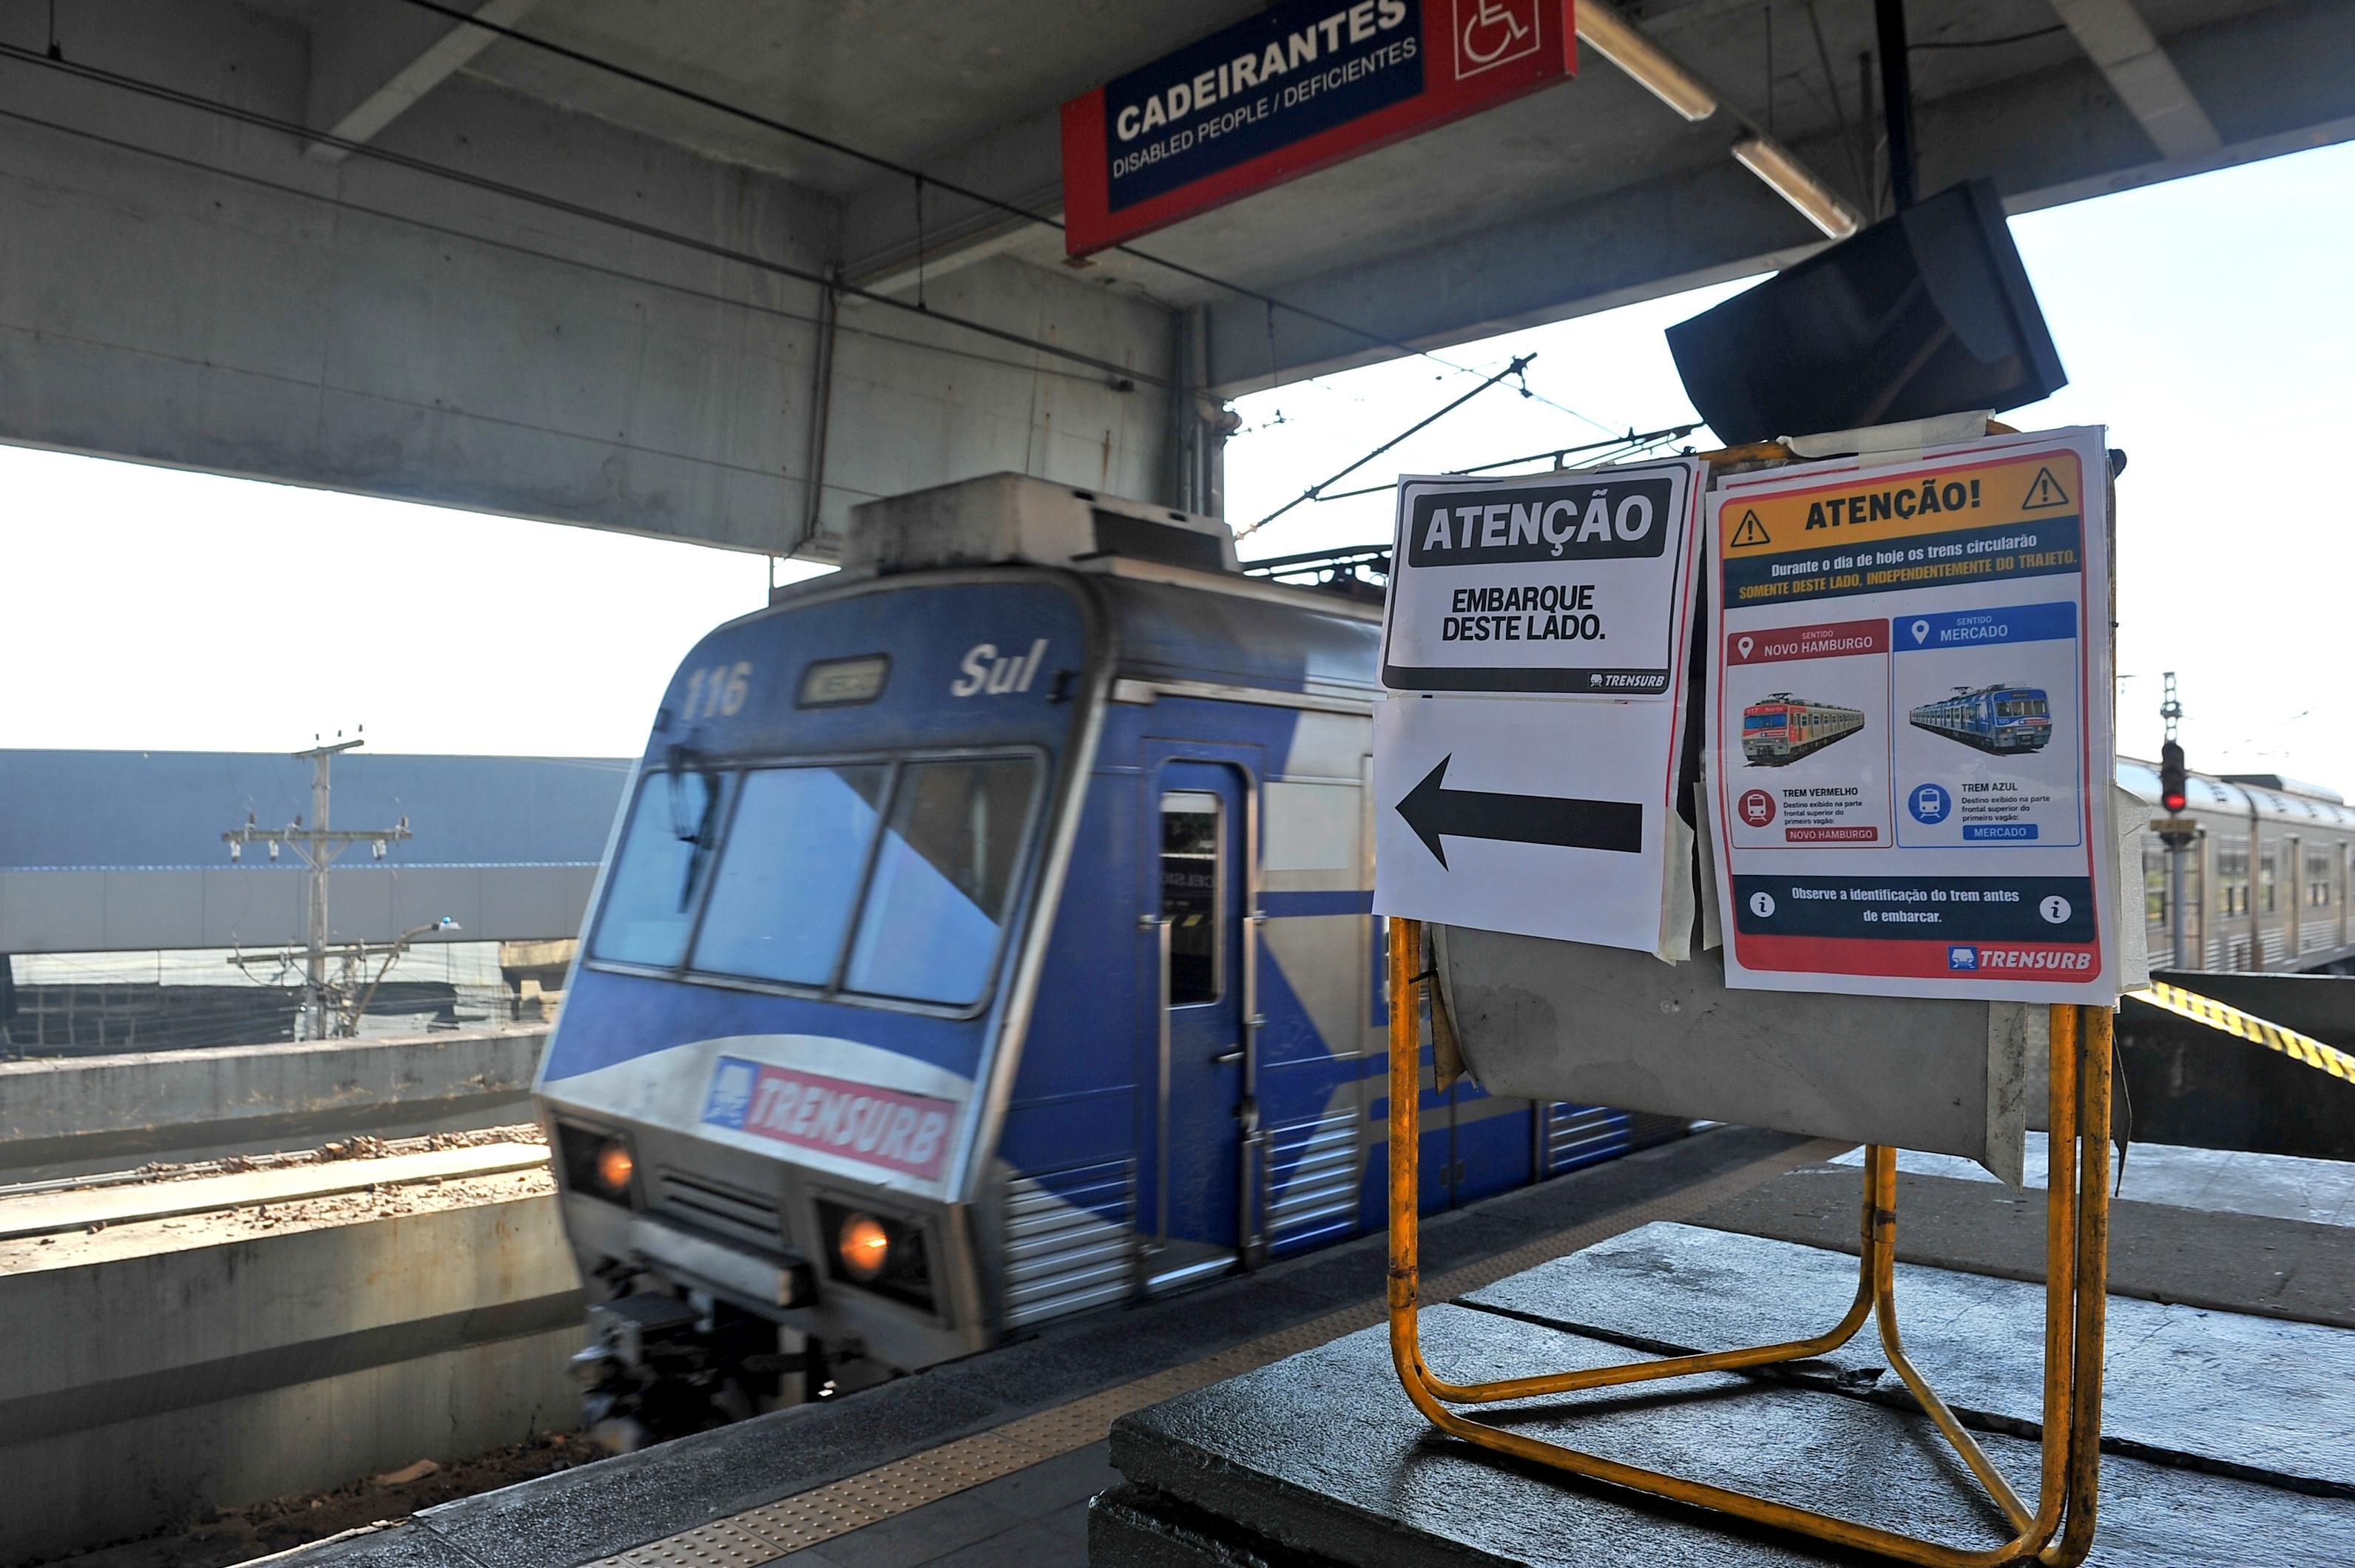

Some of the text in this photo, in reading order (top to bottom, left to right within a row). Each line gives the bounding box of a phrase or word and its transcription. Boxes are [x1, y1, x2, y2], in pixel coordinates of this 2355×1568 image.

[1117, 0, 1407, 141] CADEIRANTES
[1113, 130, 1193, 178] DISABLED
[1198, 98, 1268, 143] PEOPLE
[1285, 36, 1417, 108] DEFICIENTES
[1805, 479, 1981, 530] ATENÇÃO!
[1422, 488, 1653, 557] ATENÇÃO
[1771, 534, 2037, 577] Durante o dia de hoje os trens circularão
[1740, 550, 2077, 599] SOMENTE DESTE LADO, INDEPENDENTEMENTE DO TRAJETO.
[1452, 585, 1595, 613] EMBARQUE
[1442, 614, 1606, 641] DESTE LADO.
[1956, 615, 1992, 626] SENTIDO
[1802, 630, 1834, 640] SENTIDO
[1941, 624, 2008, 641] MERCADO
[1765, 635, 1873, 656] NOVO HAMBURGO
[951, 639, 1049, 697] Sul
[682, 662, 753, 720] 116
[1606, 675, 1665, 687] TRENSURB
[1783, 787, 1858, 797] TREM VERMELHO
[1962, 783, 2018, 792] TREM AZUL
[1962, 814, 1993, 822] primeiro
[1988, 805, 2018, 814] superior
[1790, 830, 1873, 839] NOVO HAMBURGO
[1974, 828, 2027, 837] MERCADO
[1791, 887, 2020, 904] Observe a identificação do trem antes
[1863, 910, 1942, 922] de embarcar.
[1980, 950, 2092, 970] TRENSURB
[748, 1077, 948, 1165] TRENSURB
